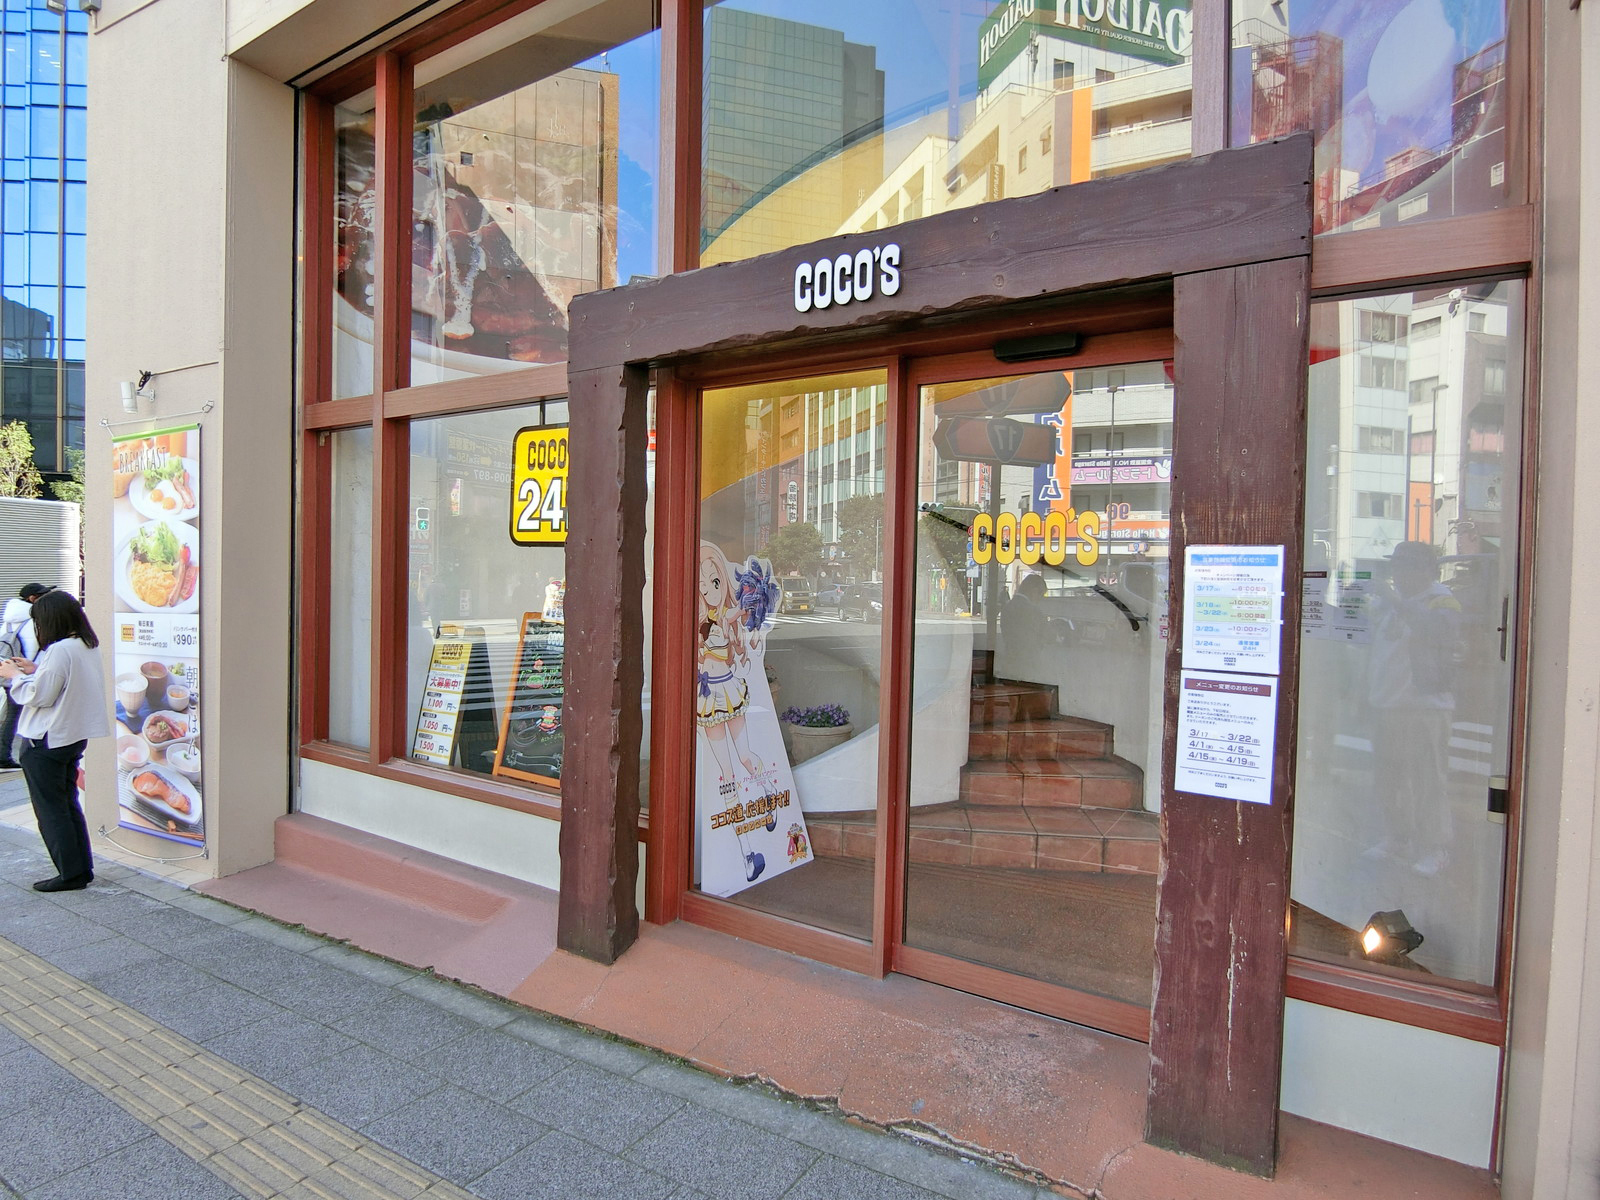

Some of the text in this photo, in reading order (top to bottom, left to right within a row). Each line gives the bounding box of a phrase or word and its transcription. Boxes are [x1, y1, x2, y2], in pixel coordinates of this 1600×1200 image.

[794, 242, 900, 313] COCO'S
[120, 446, 166, 474] BREAKFAST
[516, 476, 568, 532] 24
[972, 507, 1100, 566] COCO'S
[430, 677, 461, 689] 大募集中!
[1196, 682, 1259, 693] メニュー変更のお知らせ
